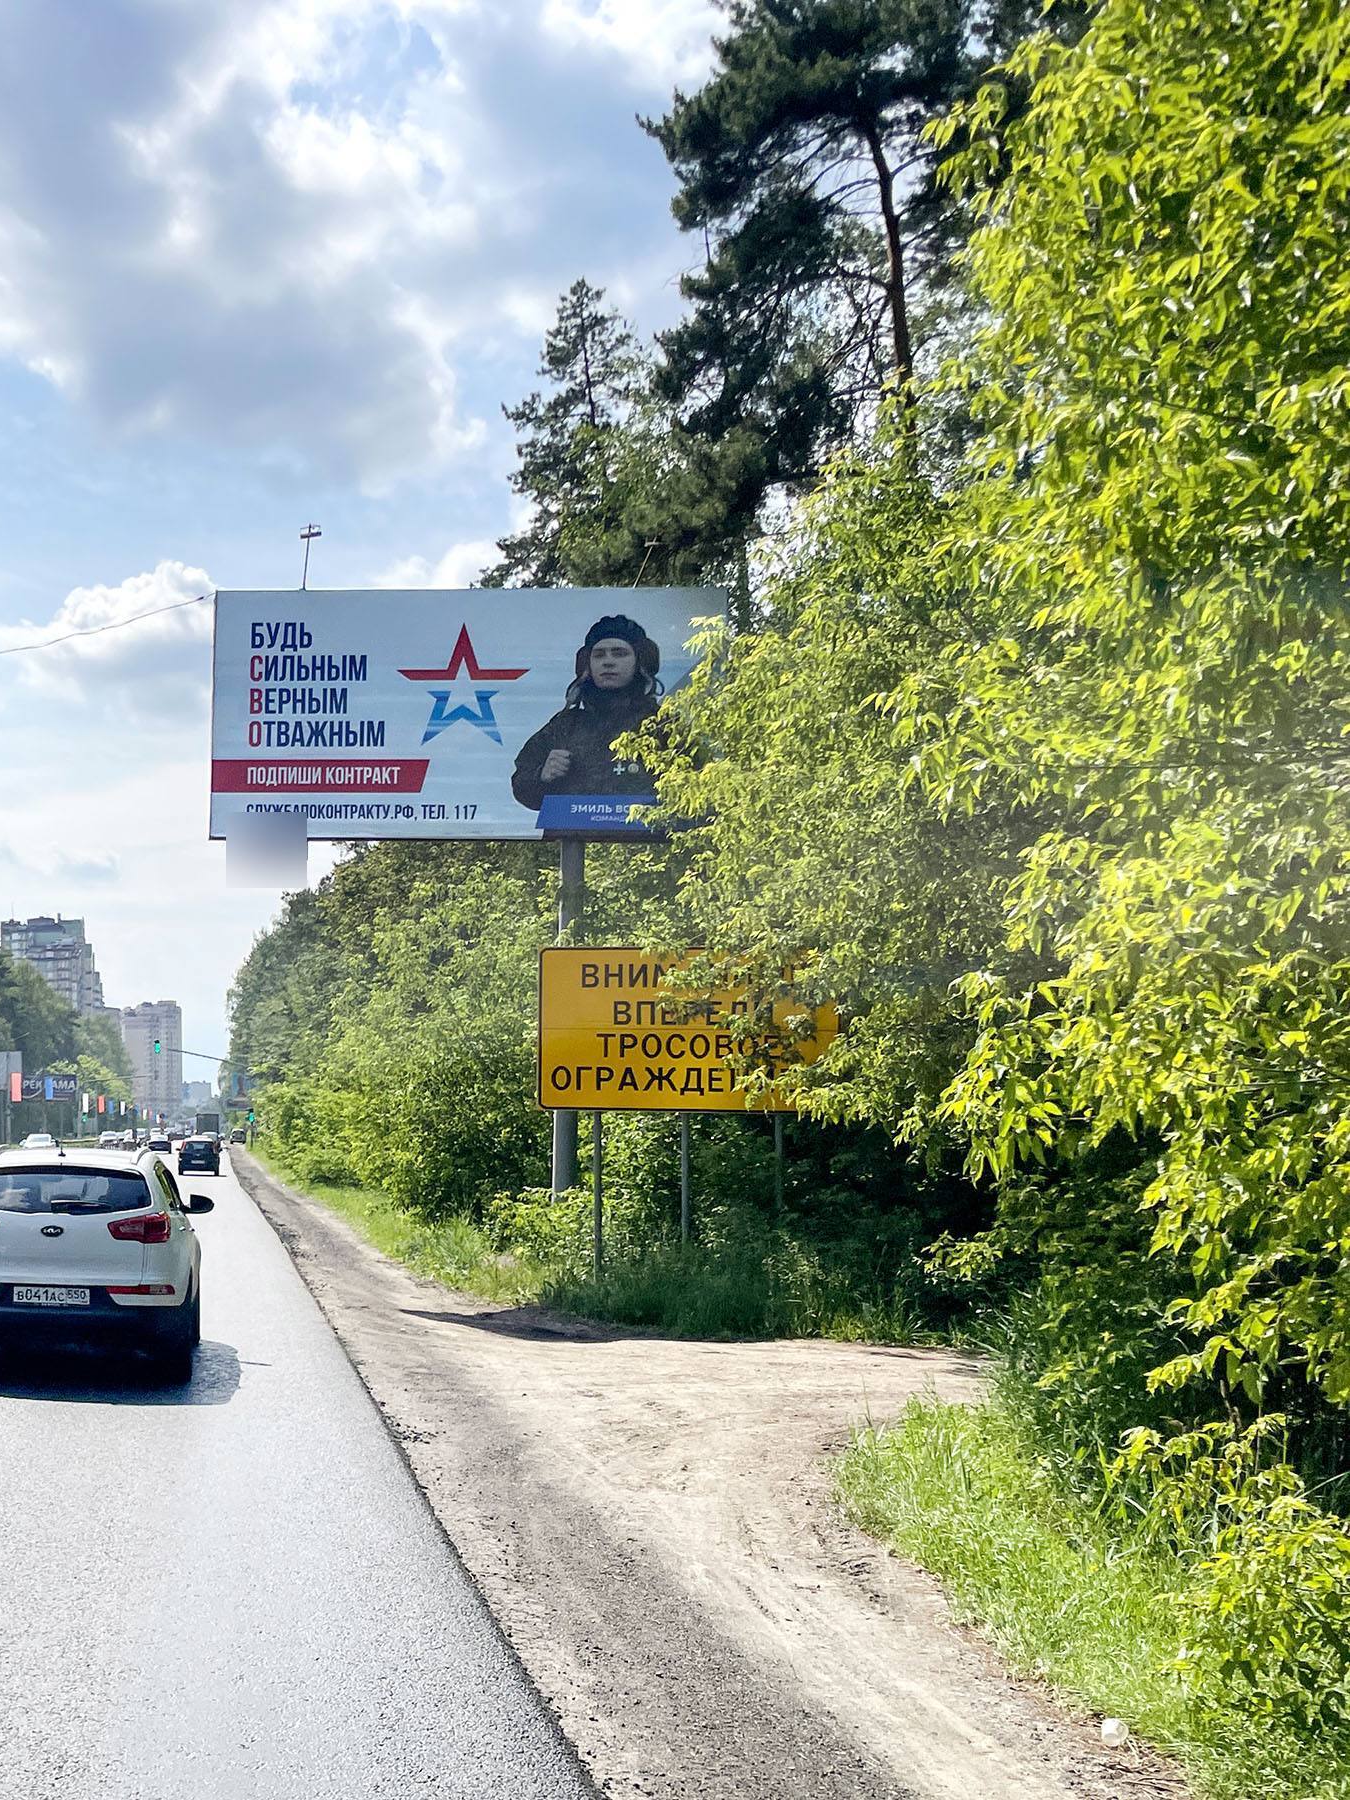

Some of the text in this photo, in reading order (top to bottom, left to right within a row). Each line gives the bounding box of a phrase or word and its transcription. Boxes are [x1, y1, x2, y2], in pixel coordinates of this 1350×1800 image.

[250, 622, 313, 652] БУДЬ
[250, 655, 367, 681] СИЛЬНЫМ
[250, 688, 347, 714] ВЕРНЫМ
[248, 720, 385, 747] ОТВАЖНЫМ
[247, 766, 400, 786] ПОДПИШИ КОНТРАКТ
[421, 804, 449, 820] ТЕЛ.
[454, 804, 477, 820] 117
[570, 804, 612, 814] ЭМИЛЬ
[23, 1080, 76, 1090] РЕКАМА
